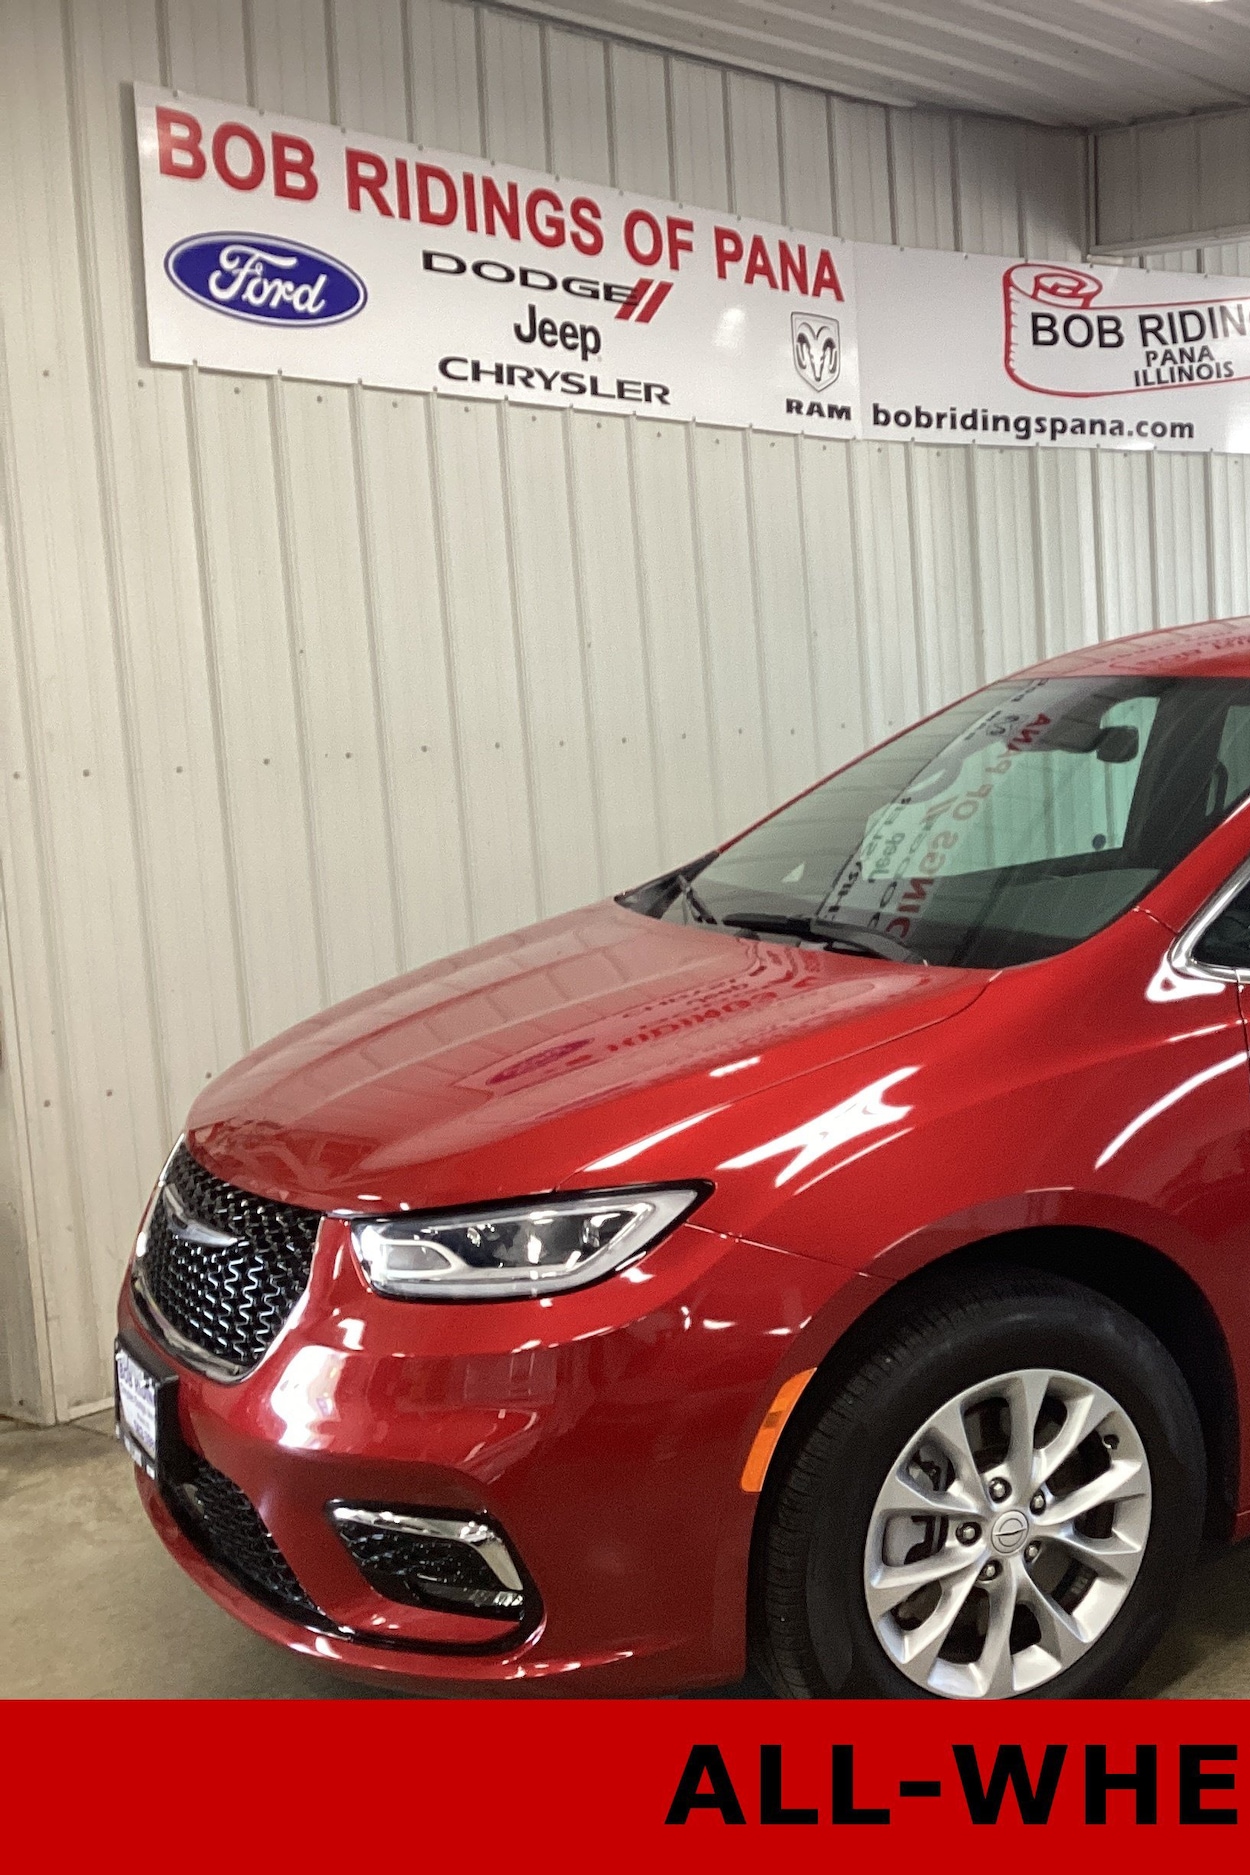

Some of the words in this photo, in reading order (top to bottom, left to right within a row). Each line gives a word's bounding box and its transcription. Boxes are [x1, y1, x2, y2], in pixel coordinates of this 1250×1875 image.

[155, 105, 319, 202] BOB
[345, 146, 604, 256] RIDINGS
[623, 208, 694, 271] OF
[714, 225, 845, 302] PANA
[208, 244, 328, 314] Ford
[421, 250, 641, 305] DODGE
[513, 303, 602, 362] Jeep
[1031, 311, 1125, 348] BOB
[1134, 361, 1235, 387] ILLINOIS
[1145, 345, 1215, 367] PANA
[437, 355, 671, 405] CHRYSLER
[785, 398, 852, 421] RAM
[872, 403, 1195, 441] bobridingspana.com
